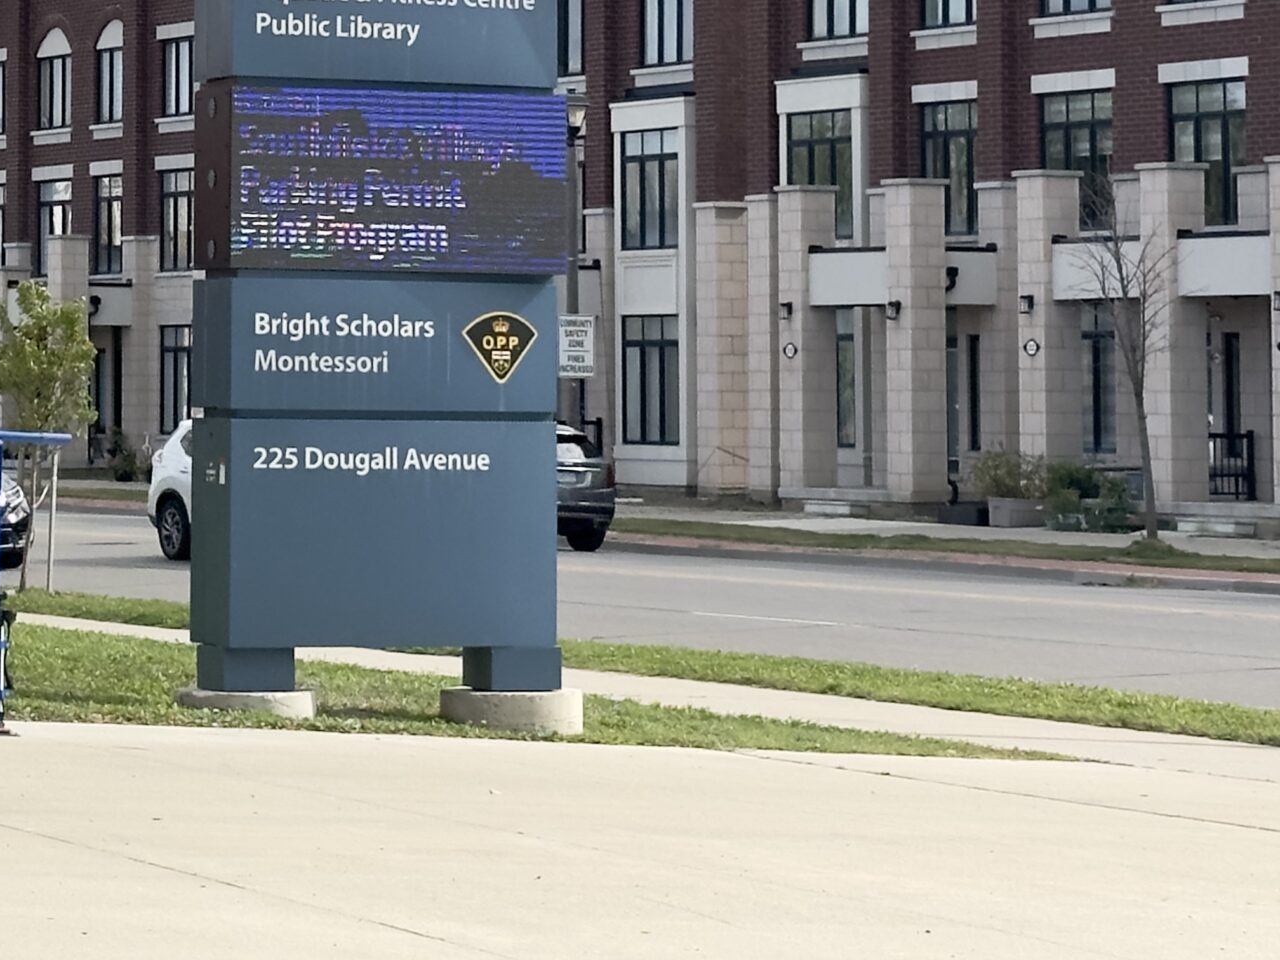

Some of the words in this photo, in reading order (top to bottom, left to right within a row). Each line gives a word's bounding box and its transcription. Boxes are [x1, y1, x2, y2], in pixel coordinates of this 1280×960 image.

[255, 12, 330, 37] Public
[336, 15, 420, 46] Library
[240, 165, 358, 213] Parking
[254, 312, 331, 341] Bright
[335, 313, 435, 338] Scholars
[254, 349, 389, 373] Montessori
[253, 447, 298, 469] 225
[305, 446, 398, 476] Dougall
[403, 448, 491, 471] Avenue
